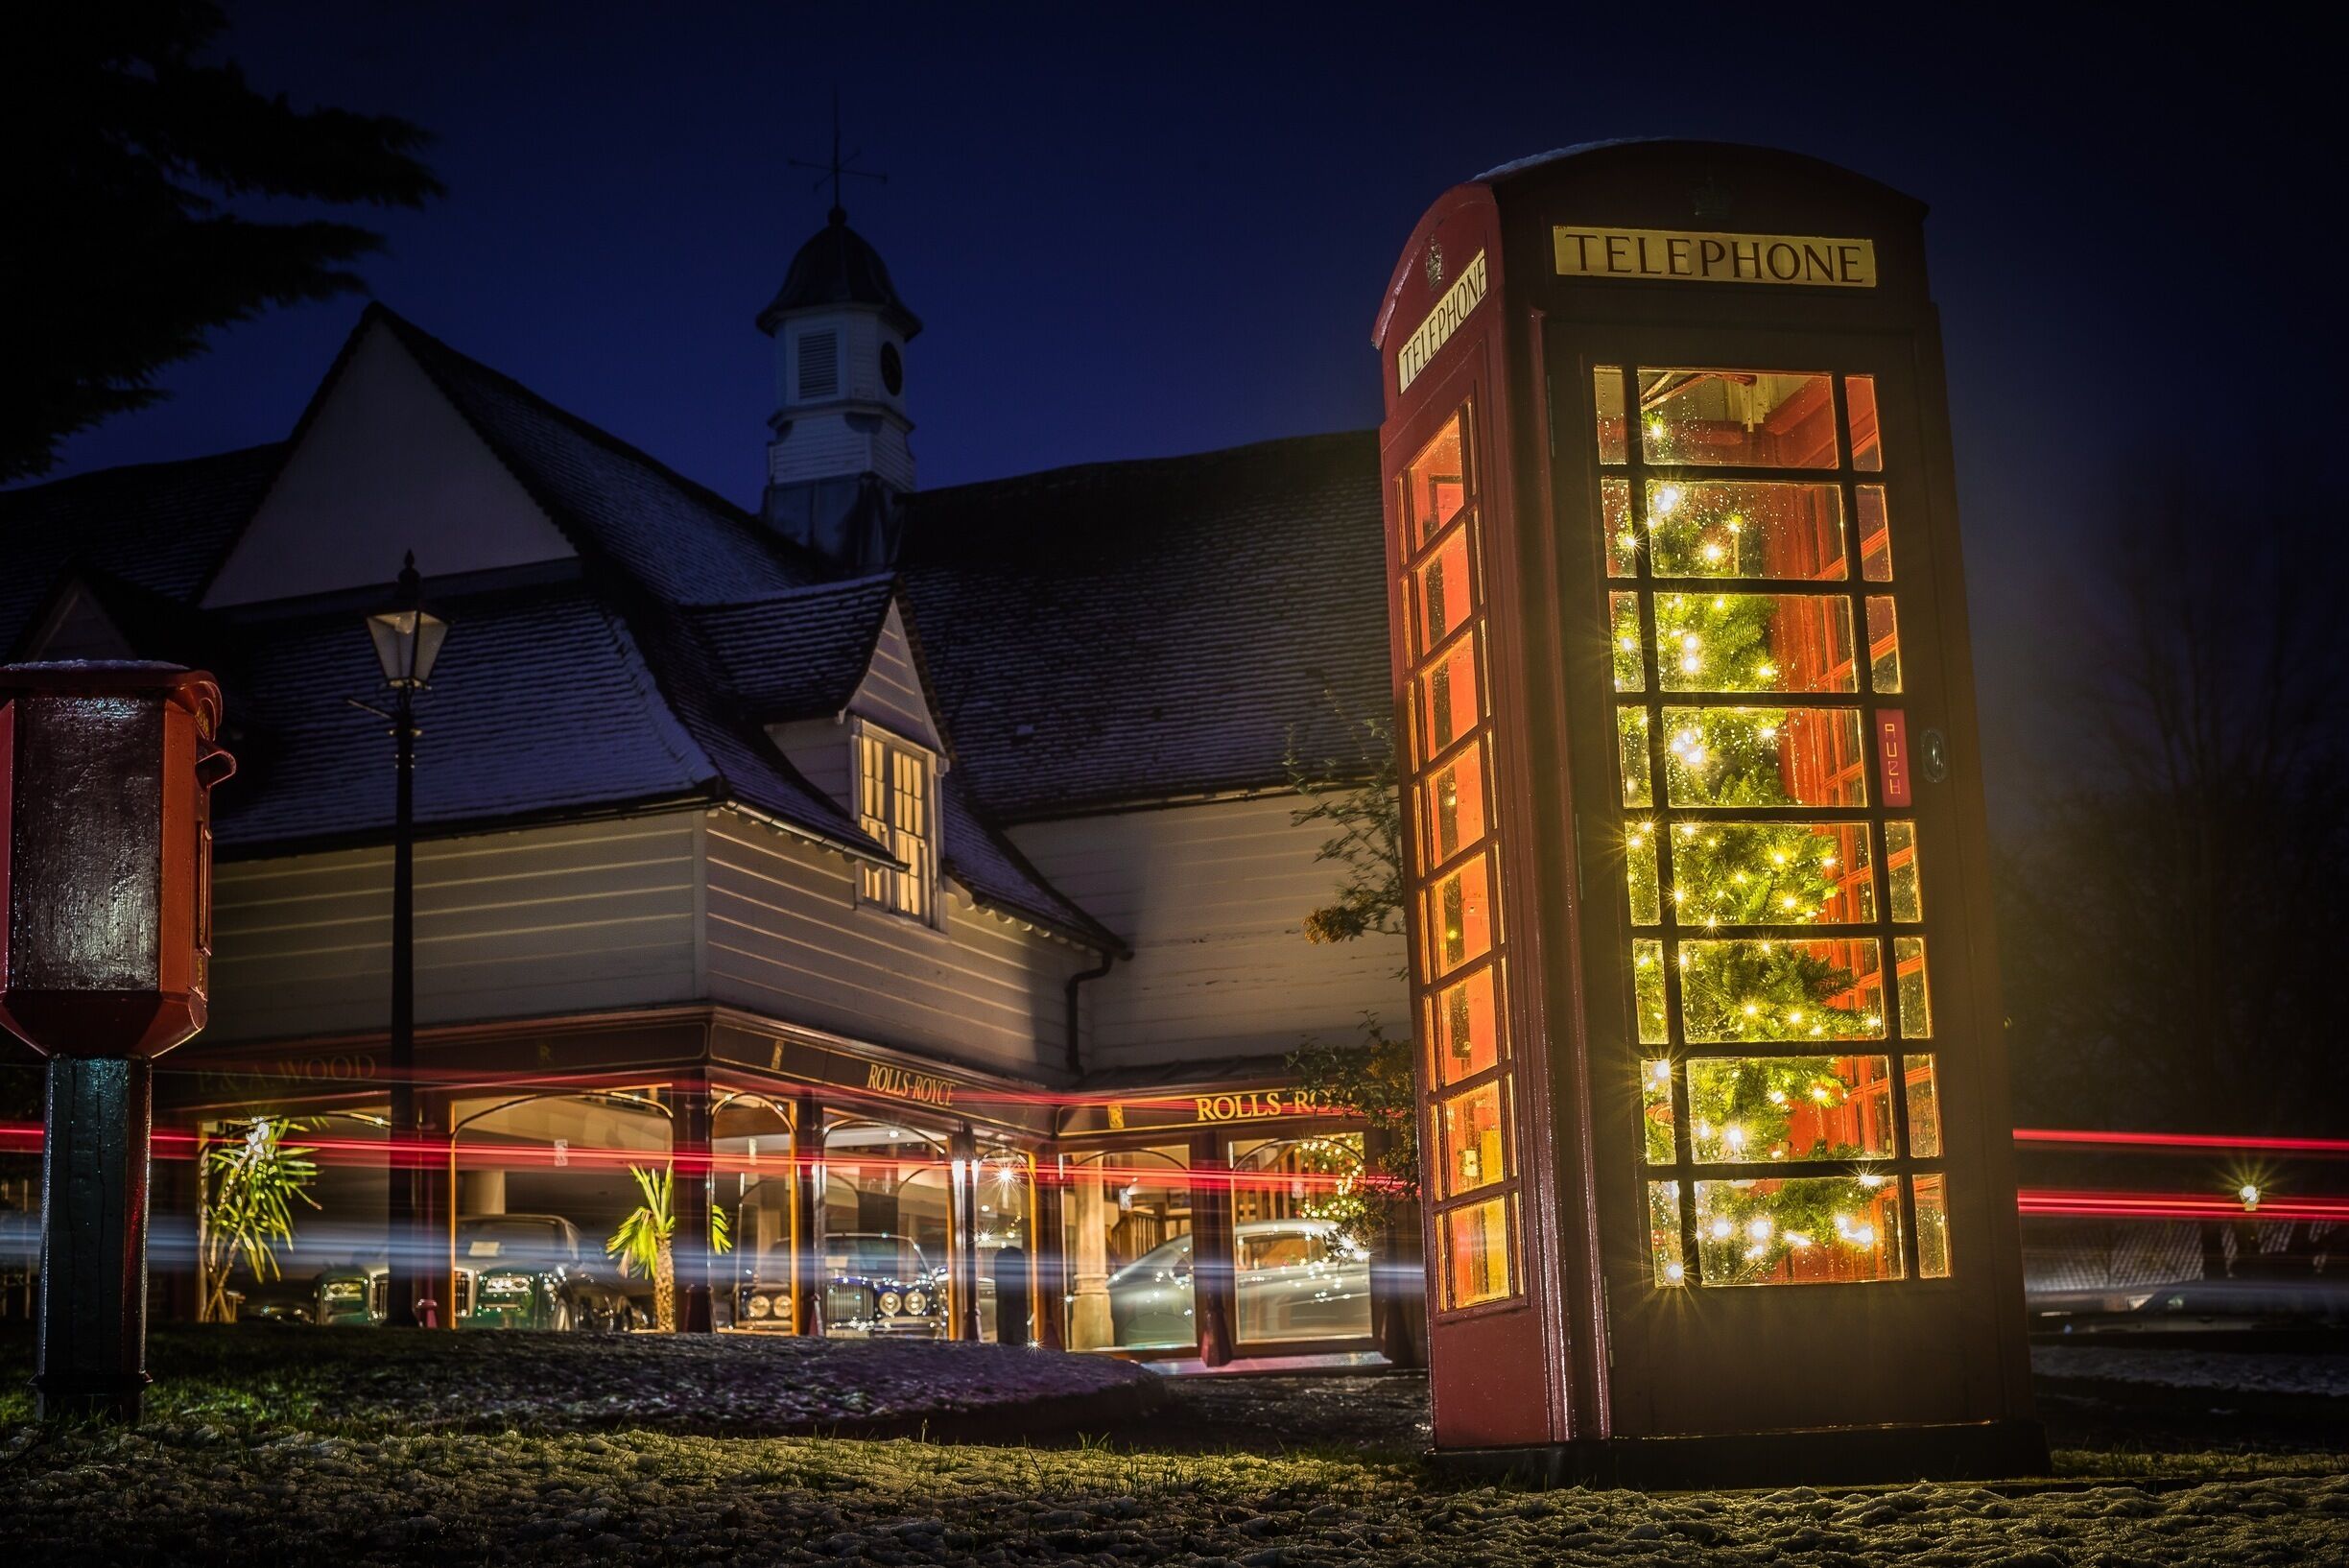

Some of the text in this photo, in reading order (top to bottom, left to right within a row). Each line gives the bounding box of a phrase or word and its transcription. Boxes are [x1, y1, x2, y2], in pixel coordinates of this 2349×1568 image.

[1566, 234, 1864, 284] TELEPHONE
[1402, 255, 1488, 378] TELEPHONE
[277, 1053, 377, 1084] WOOD
[867, 1063, 956, 1107] ROLLS-ROYCE
